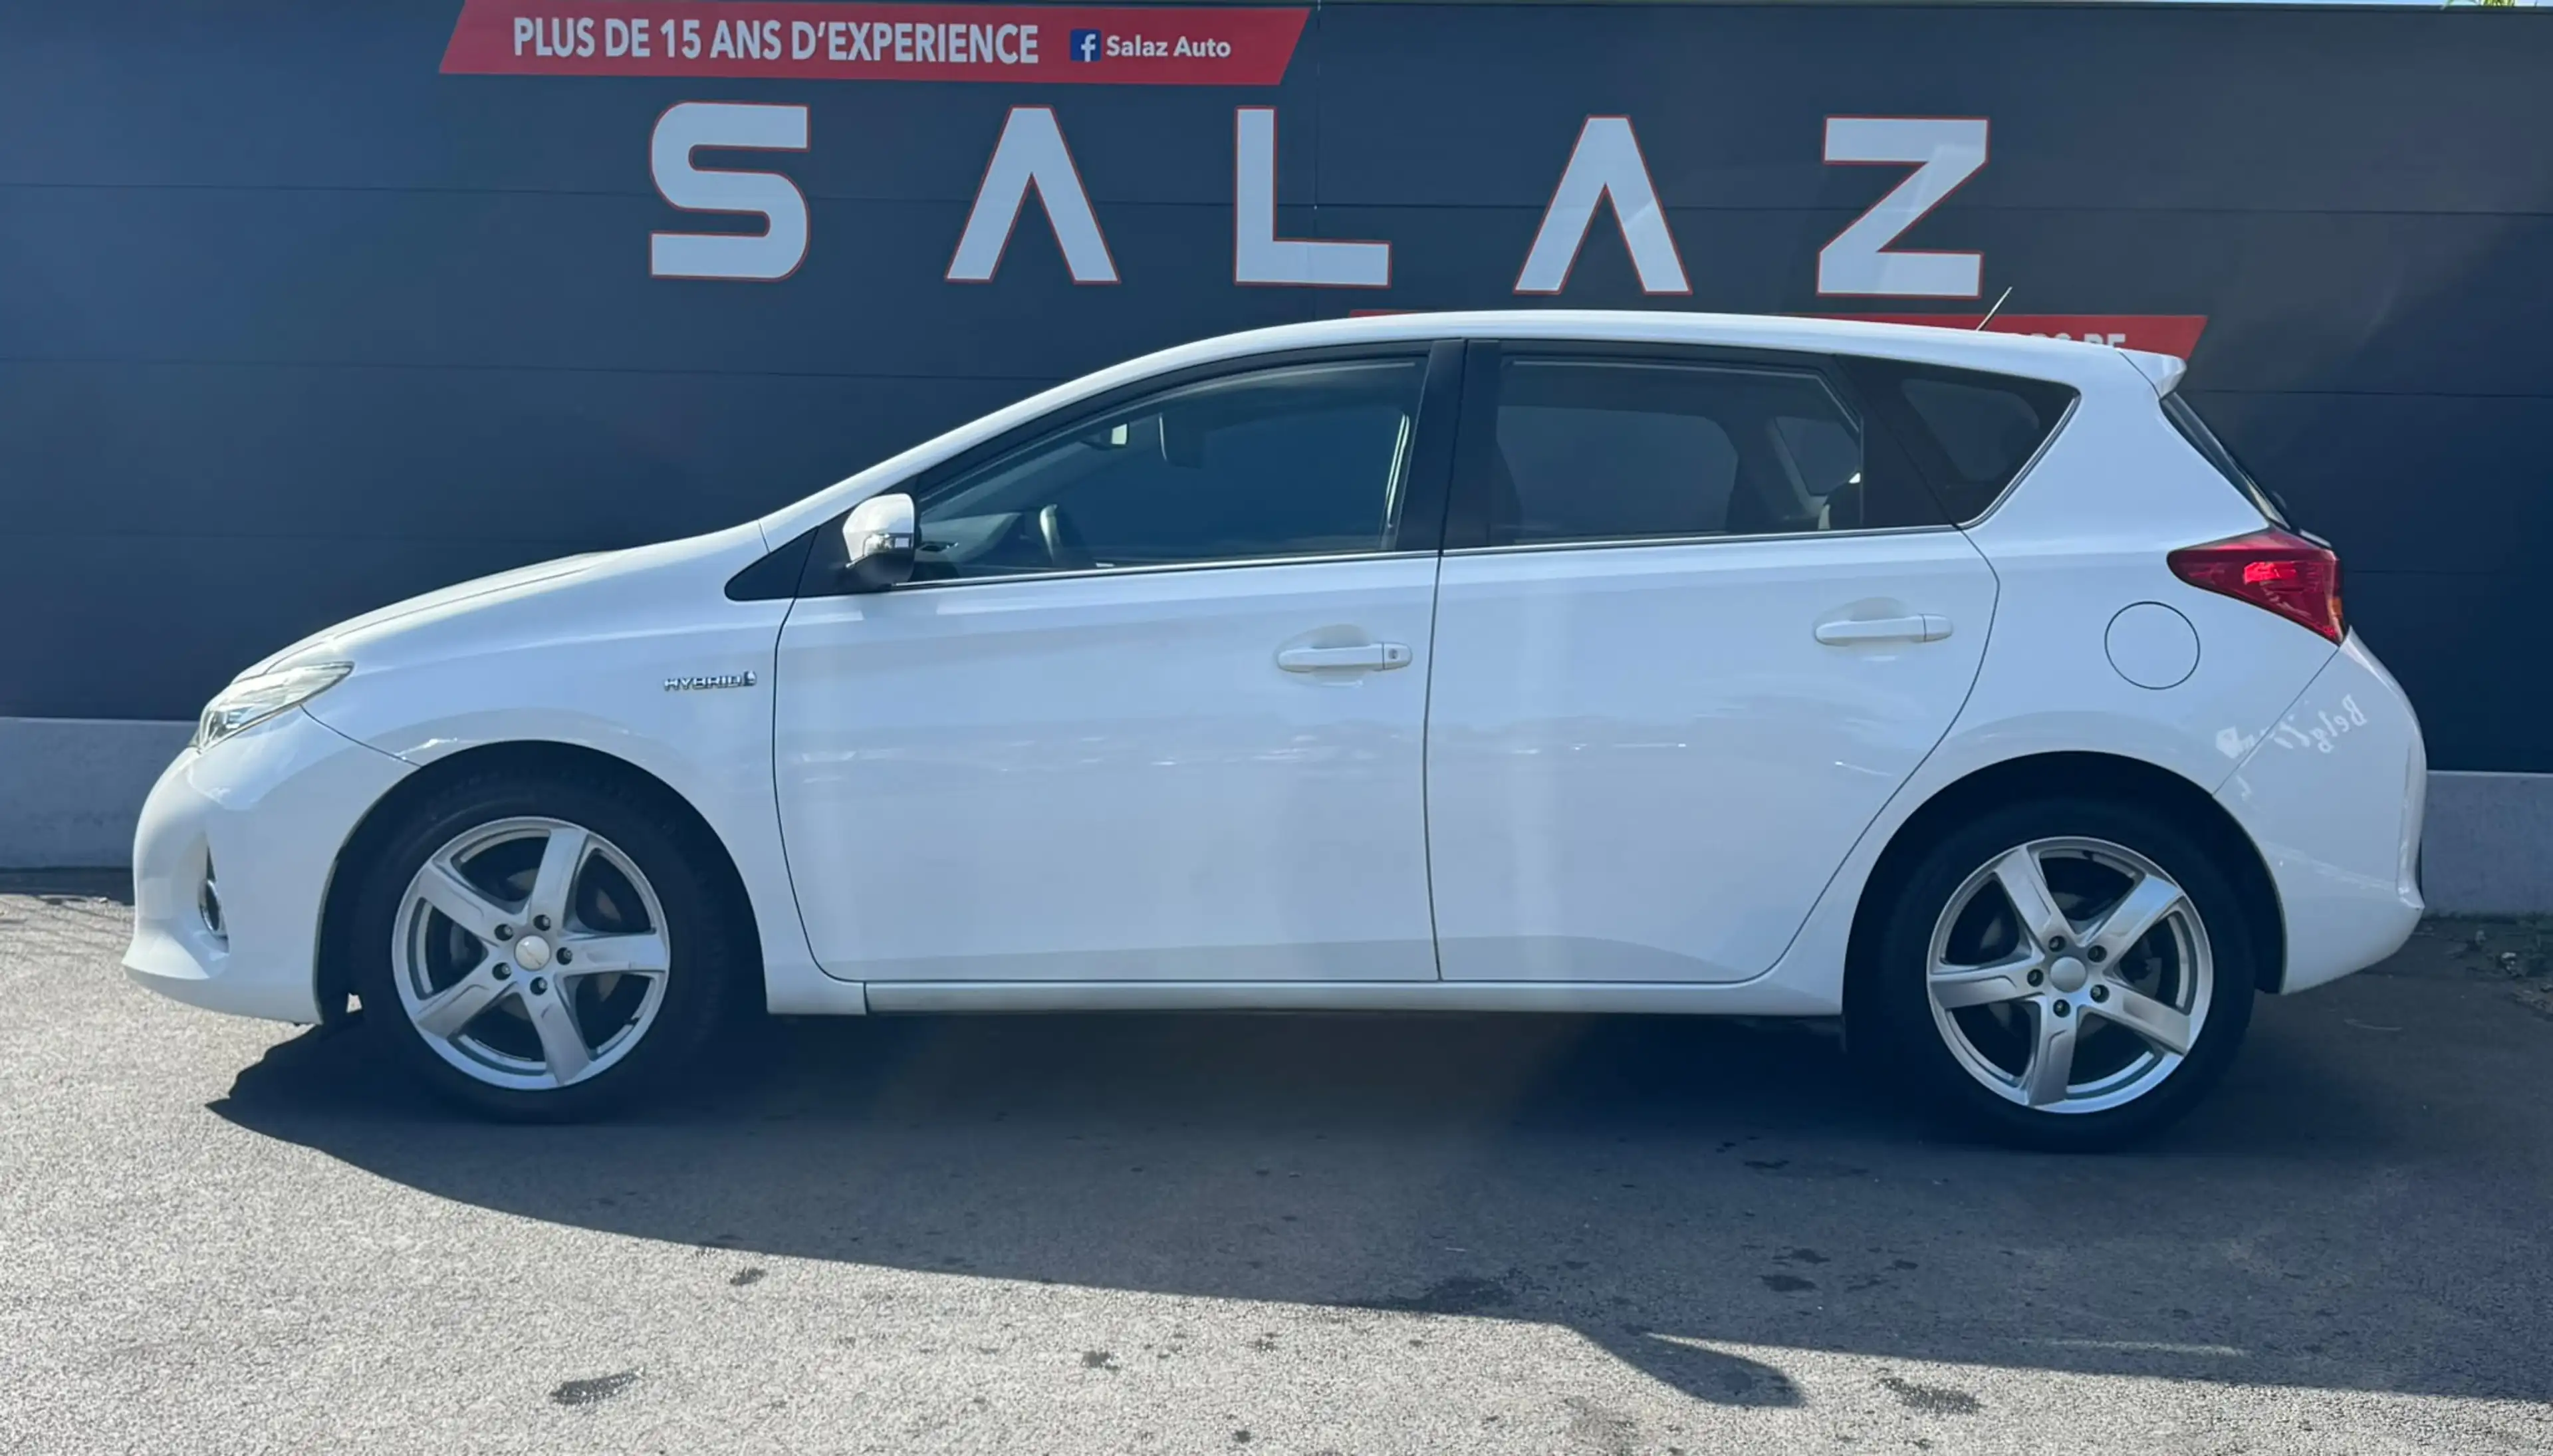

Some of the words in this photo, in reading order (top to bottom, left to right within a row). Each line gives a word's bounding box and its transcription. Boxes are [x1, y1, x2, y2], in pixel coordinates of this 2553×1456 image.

[513, 17, 596, 57] PLUS
[605, 18, 650, 57] DE
[660, 19, 701, 59] 15
[709, 20, 782, 60] ANS
[791, 21, 1039, 64] D'EXPERIENCE
[1106, 35, 1168, 57] Salaz
[1173, 36, 1231, 58] Auto
[664, 675, 743, 691] HYBRID
